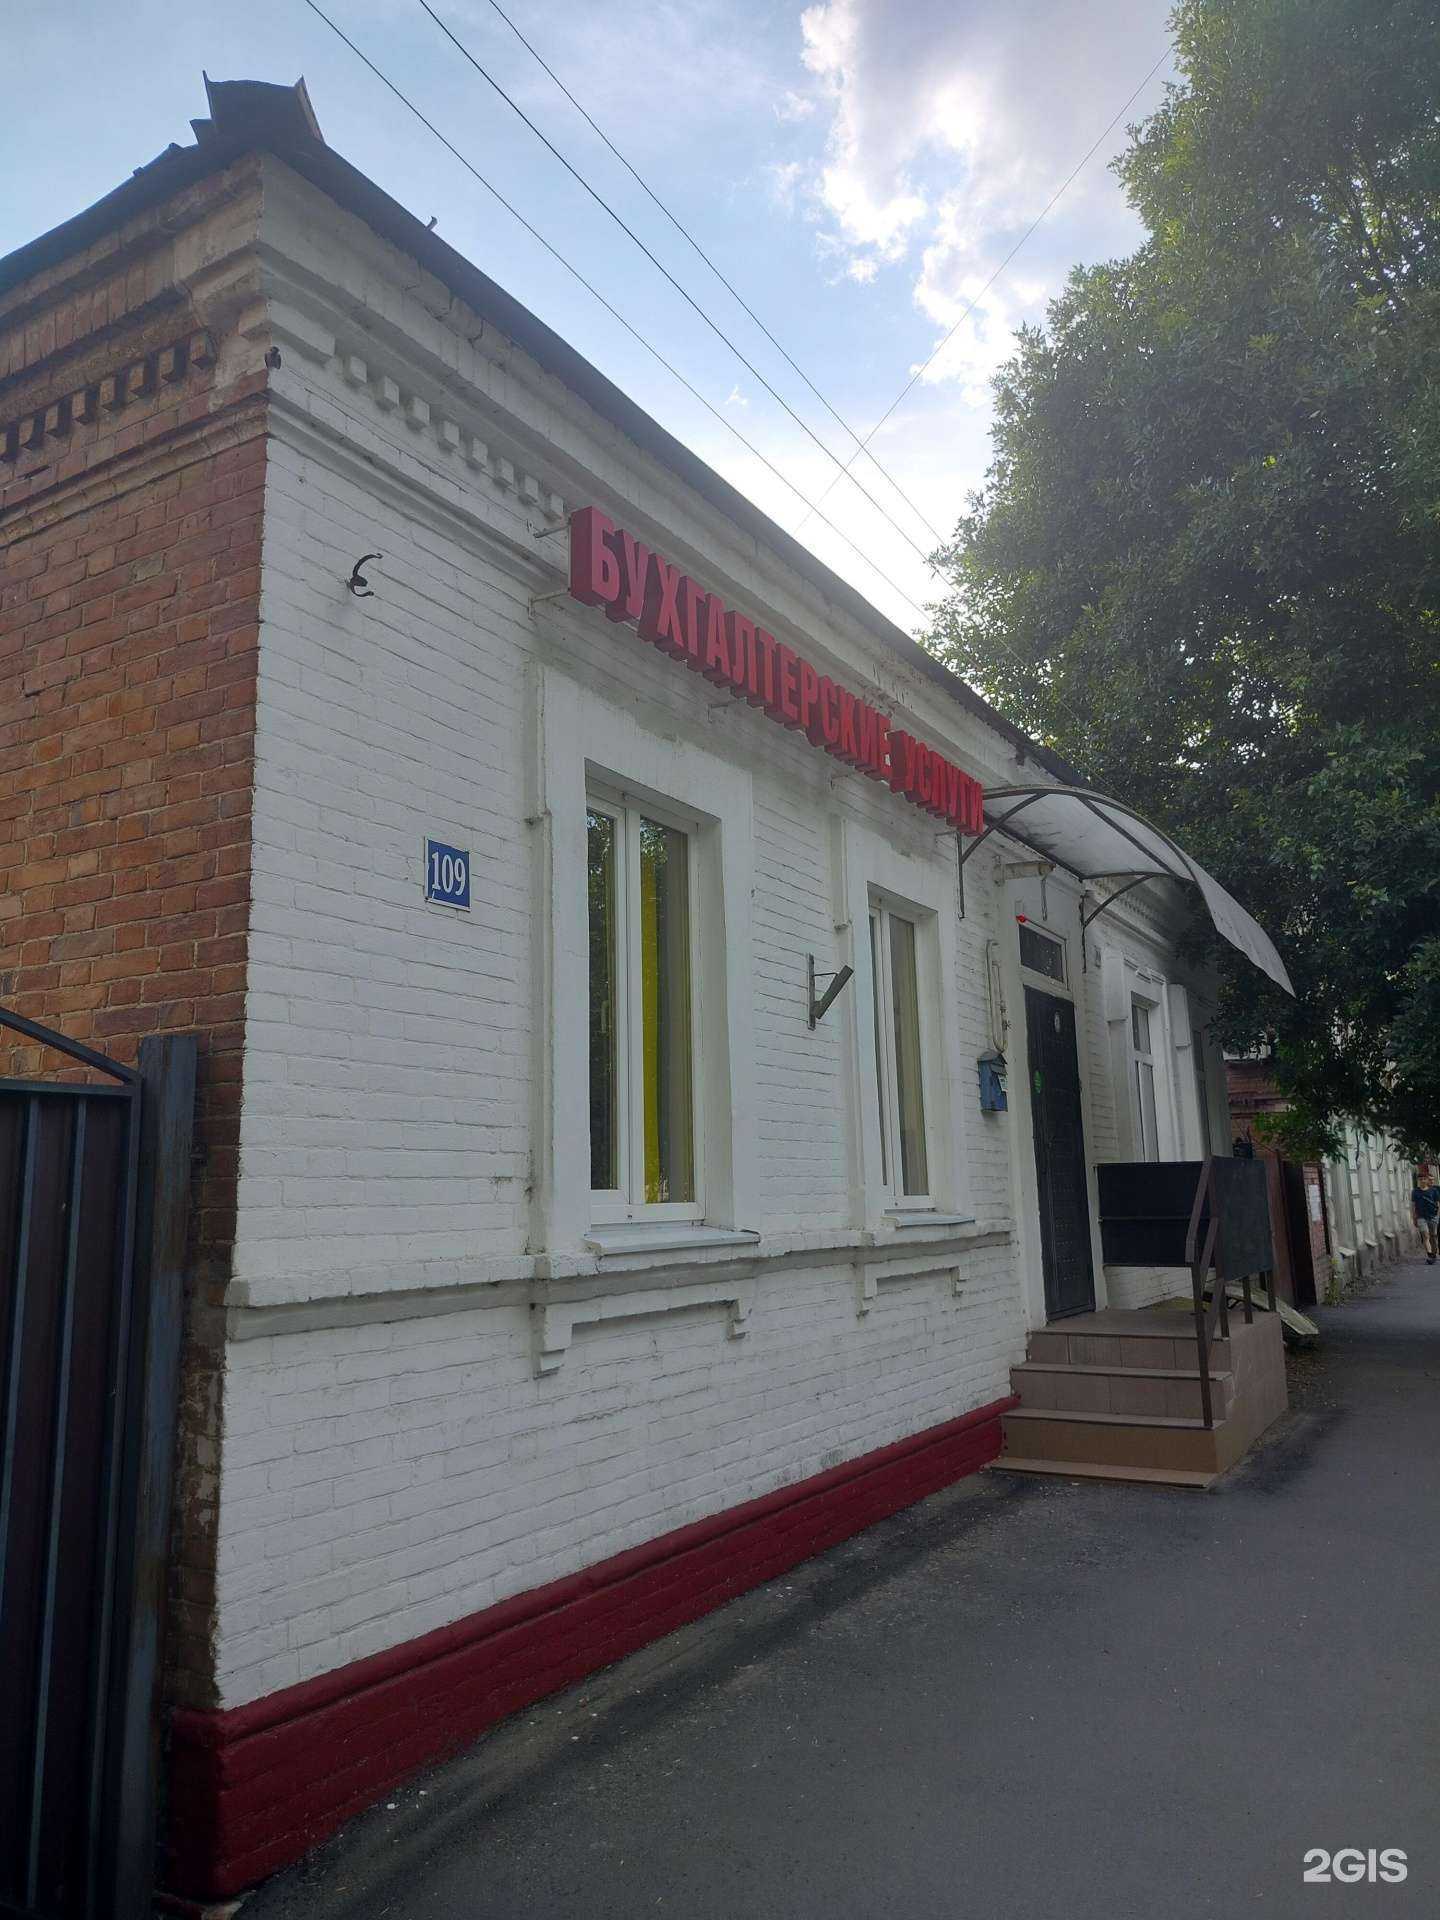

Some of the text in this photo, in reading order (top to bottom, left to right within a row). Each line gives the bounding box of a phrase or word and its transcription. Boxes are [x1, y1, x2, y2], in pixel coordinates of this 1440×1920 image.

[571, 506, 983, 836] БУХГАЛТЕРСКИЕ УСЛУГИ
[431, 851, 466, 896] 109
